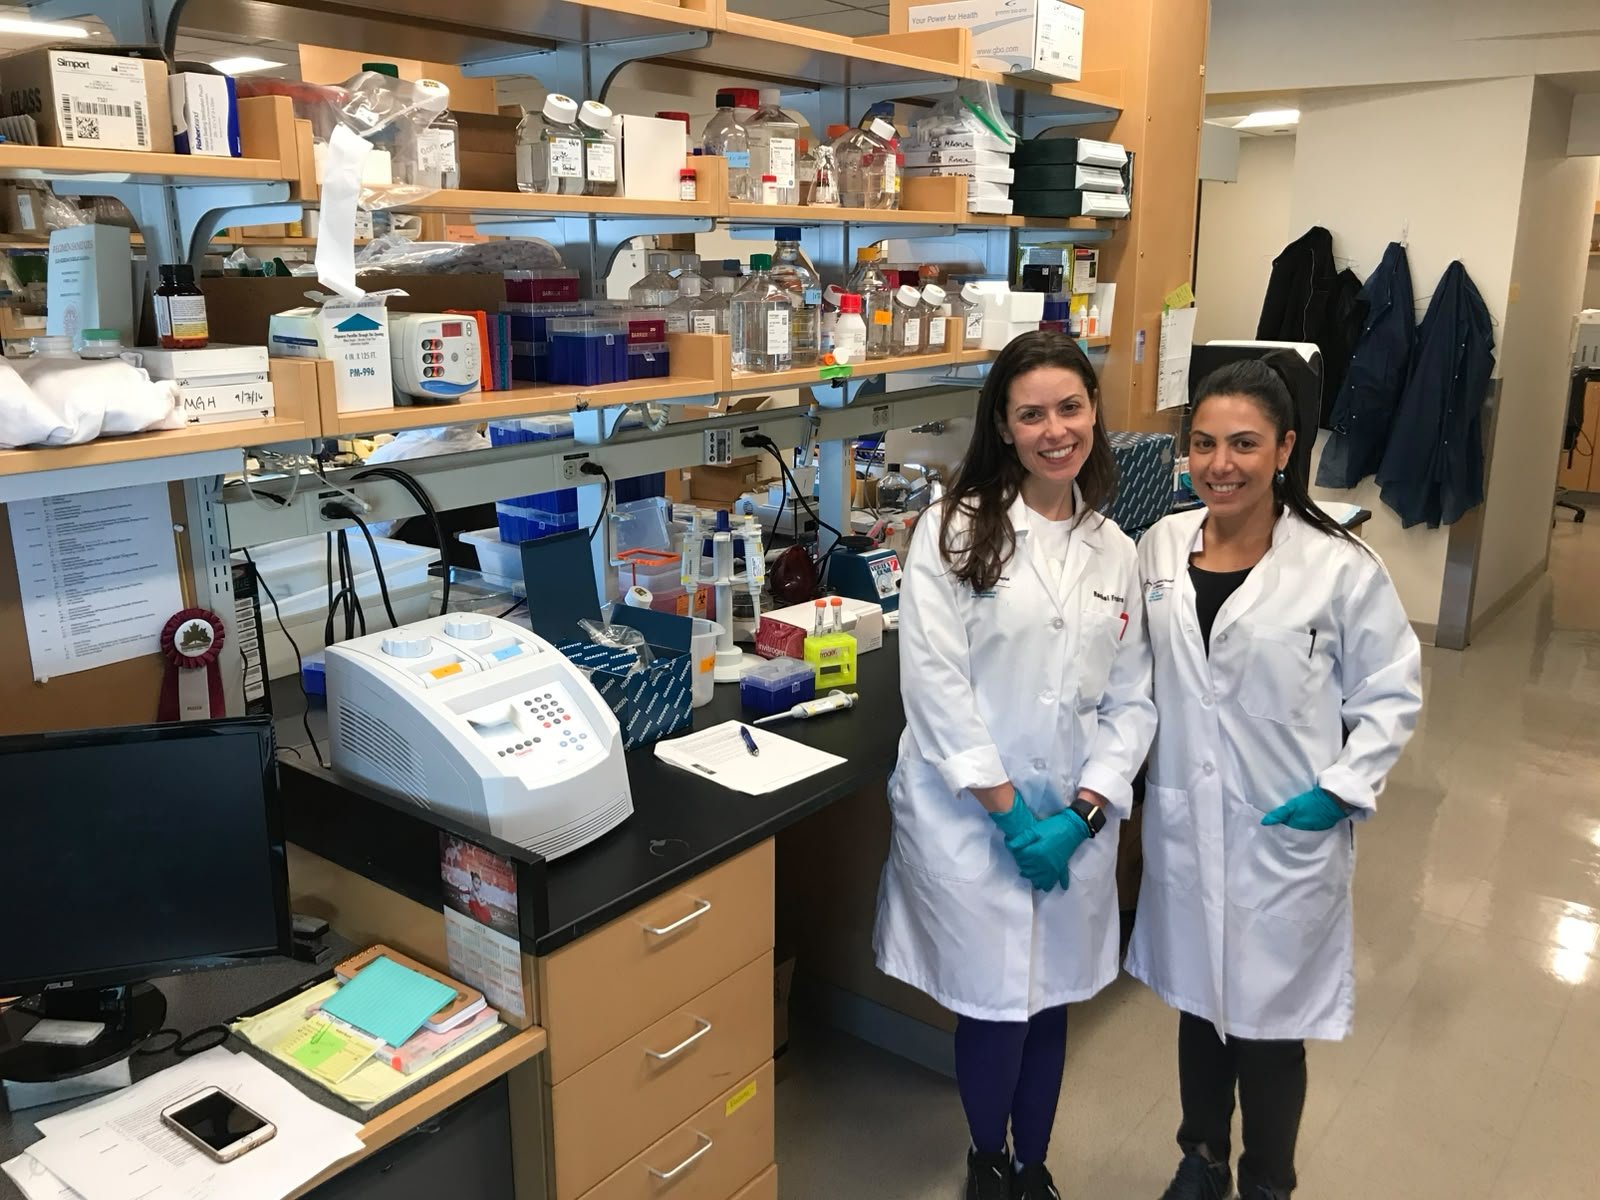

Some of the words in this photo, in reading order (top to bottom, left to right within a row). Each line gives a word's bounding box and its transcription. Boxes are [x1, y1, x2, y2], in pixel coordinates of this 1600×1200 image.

[911, 17, 926, 25] Your
[927, 15, 946, 23] Power
[947, 13, 957, 21] for
[958, 11, 978, 20] Health
[976, 45, 1019, 55] www.gbo.com
[57, 58, 90, 69] Simport
[349, 367, 375, 377] PM-996
[234, 390, 263, 405] 9/7/16
[584, 651, 608, 661] QIAGEN
[758, 642, 787, 657] invitrogen
[679, 660, 691, 681] QIAGEN
[600, 677, 616, 694] QIAGEN
[633, 681, 648, 703] QIAGEN
[663, 675, 676, 698] QIAGEN
[612, 696, 629, 713] QIAGEN
[645, 692, 659, 714] QIAGEN
[673, 686, 686, 709] QIAGEN
[626, 708, 641, 731] QIAGEN
[656, 703, 670, 725] QIAGEN
[639, 720, 653, 742] QIAGEN
[666, 714, 680, 735] QIAGEN
[44, 980, 74, 991] ASUS
